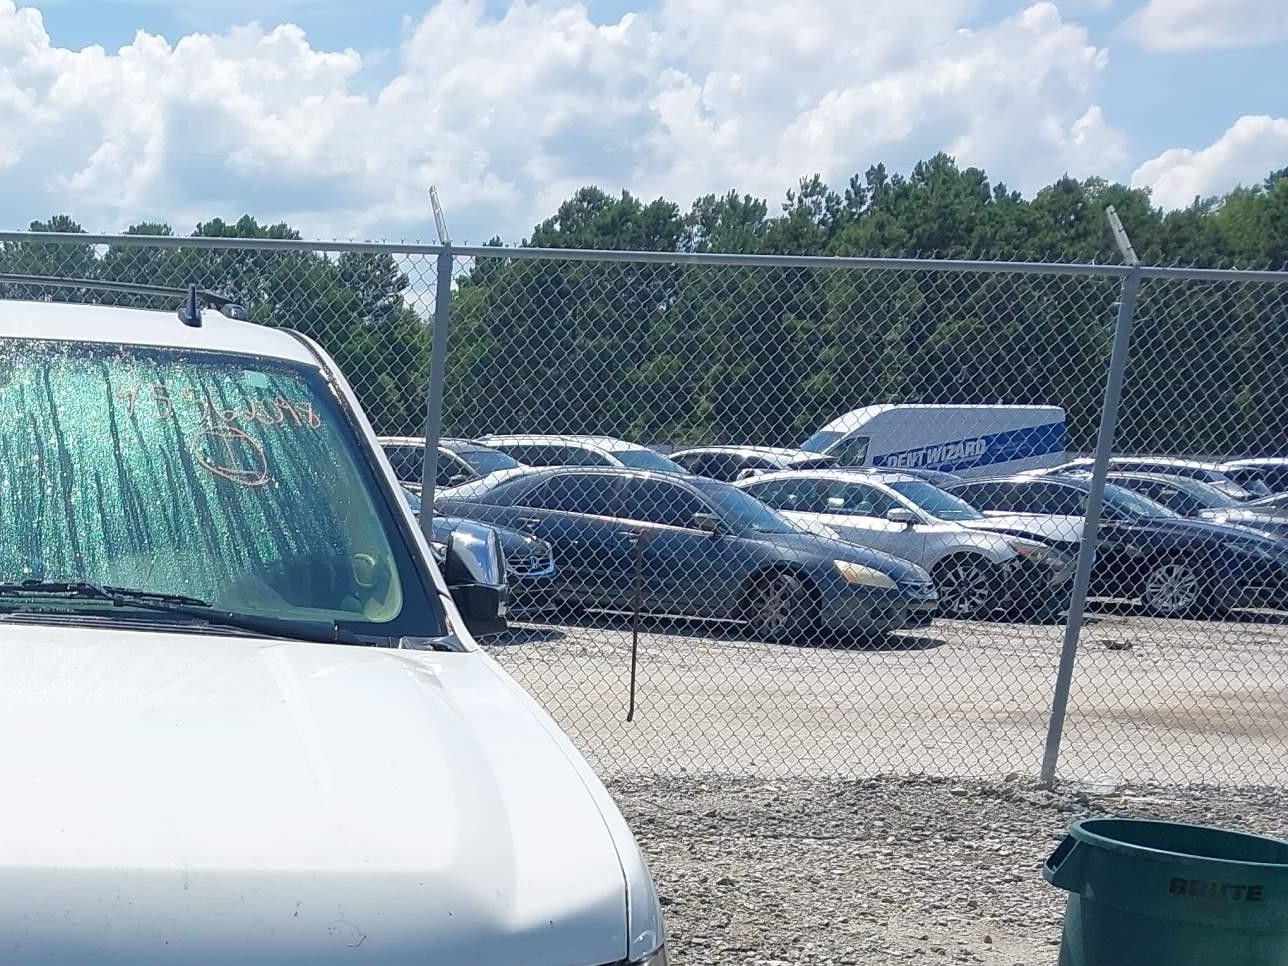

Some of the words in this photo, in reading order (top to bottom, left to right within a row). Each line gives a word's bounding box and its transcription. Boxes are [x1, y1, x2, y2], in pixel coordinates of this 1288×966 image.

[887, 448, 928, 467] DENT
[927, 439, 987, 464] WIZARD
[1169, 877, 1264, 901] BRUTE
